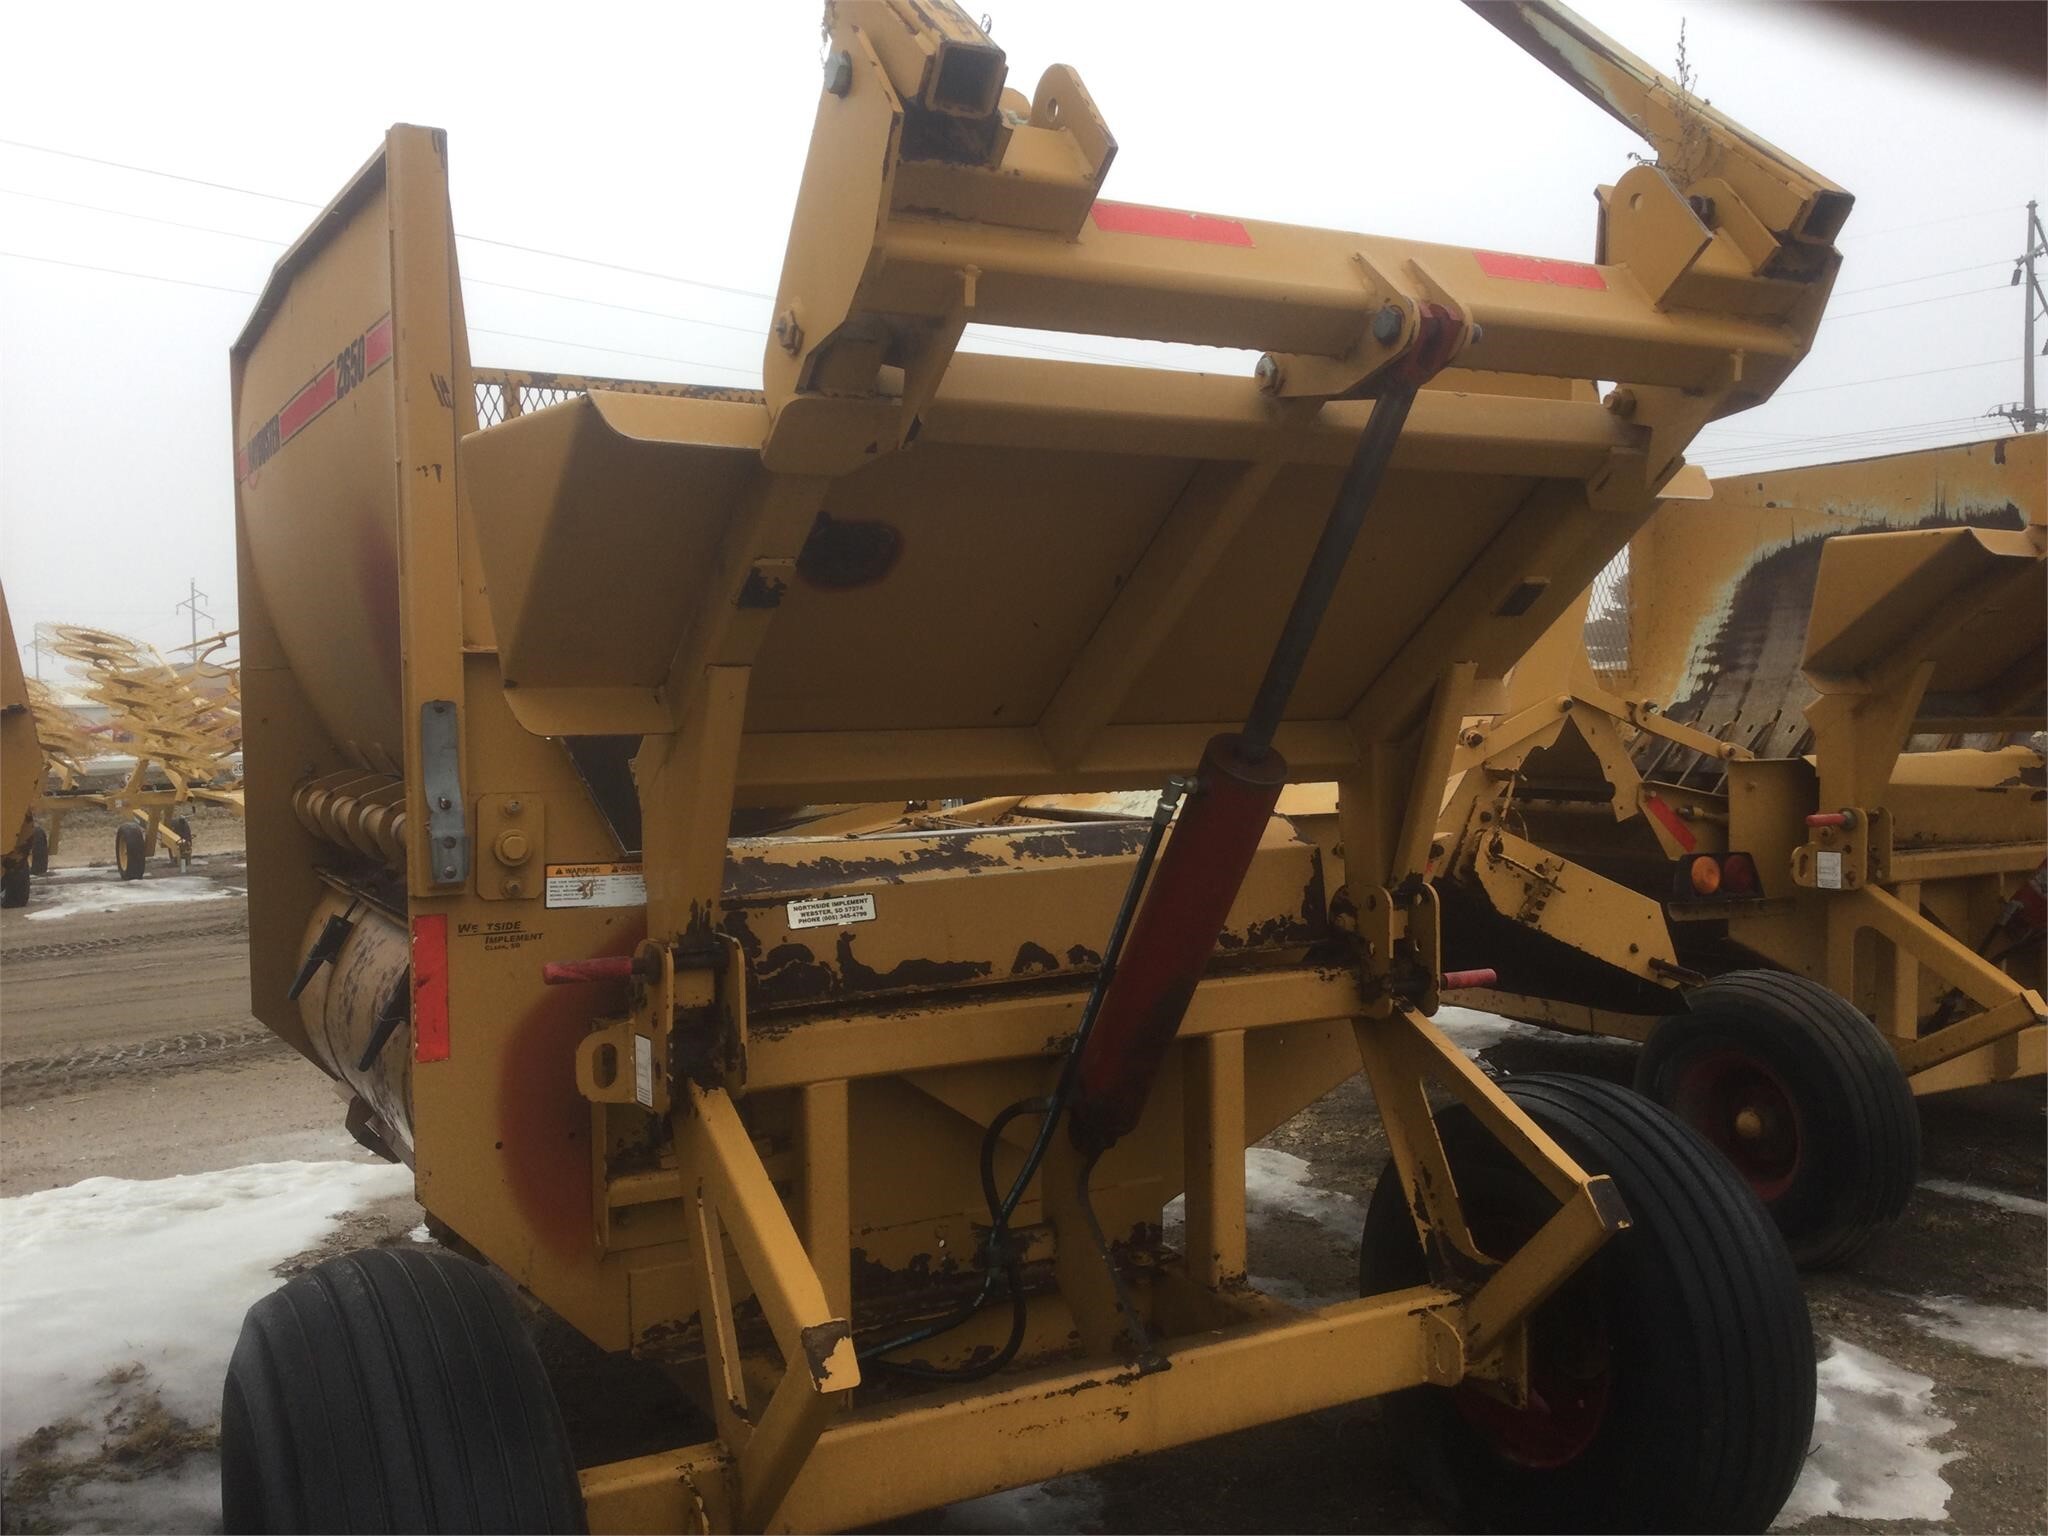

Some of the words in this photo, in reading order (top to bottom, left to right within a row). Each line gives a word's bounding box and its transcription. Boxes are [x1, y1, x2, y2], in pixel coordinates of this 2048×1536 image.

[337, 334, 365, 400] 2650
[793, 902, 830, 912] NORTHSIDE
[831, 898, 868, 907] IMPLEMENT
[798, 916, 820, 924] PHONE
[458, 921, 521, 934] WETSIDE
[485, 932, 544, 944] IMPLEMENT
